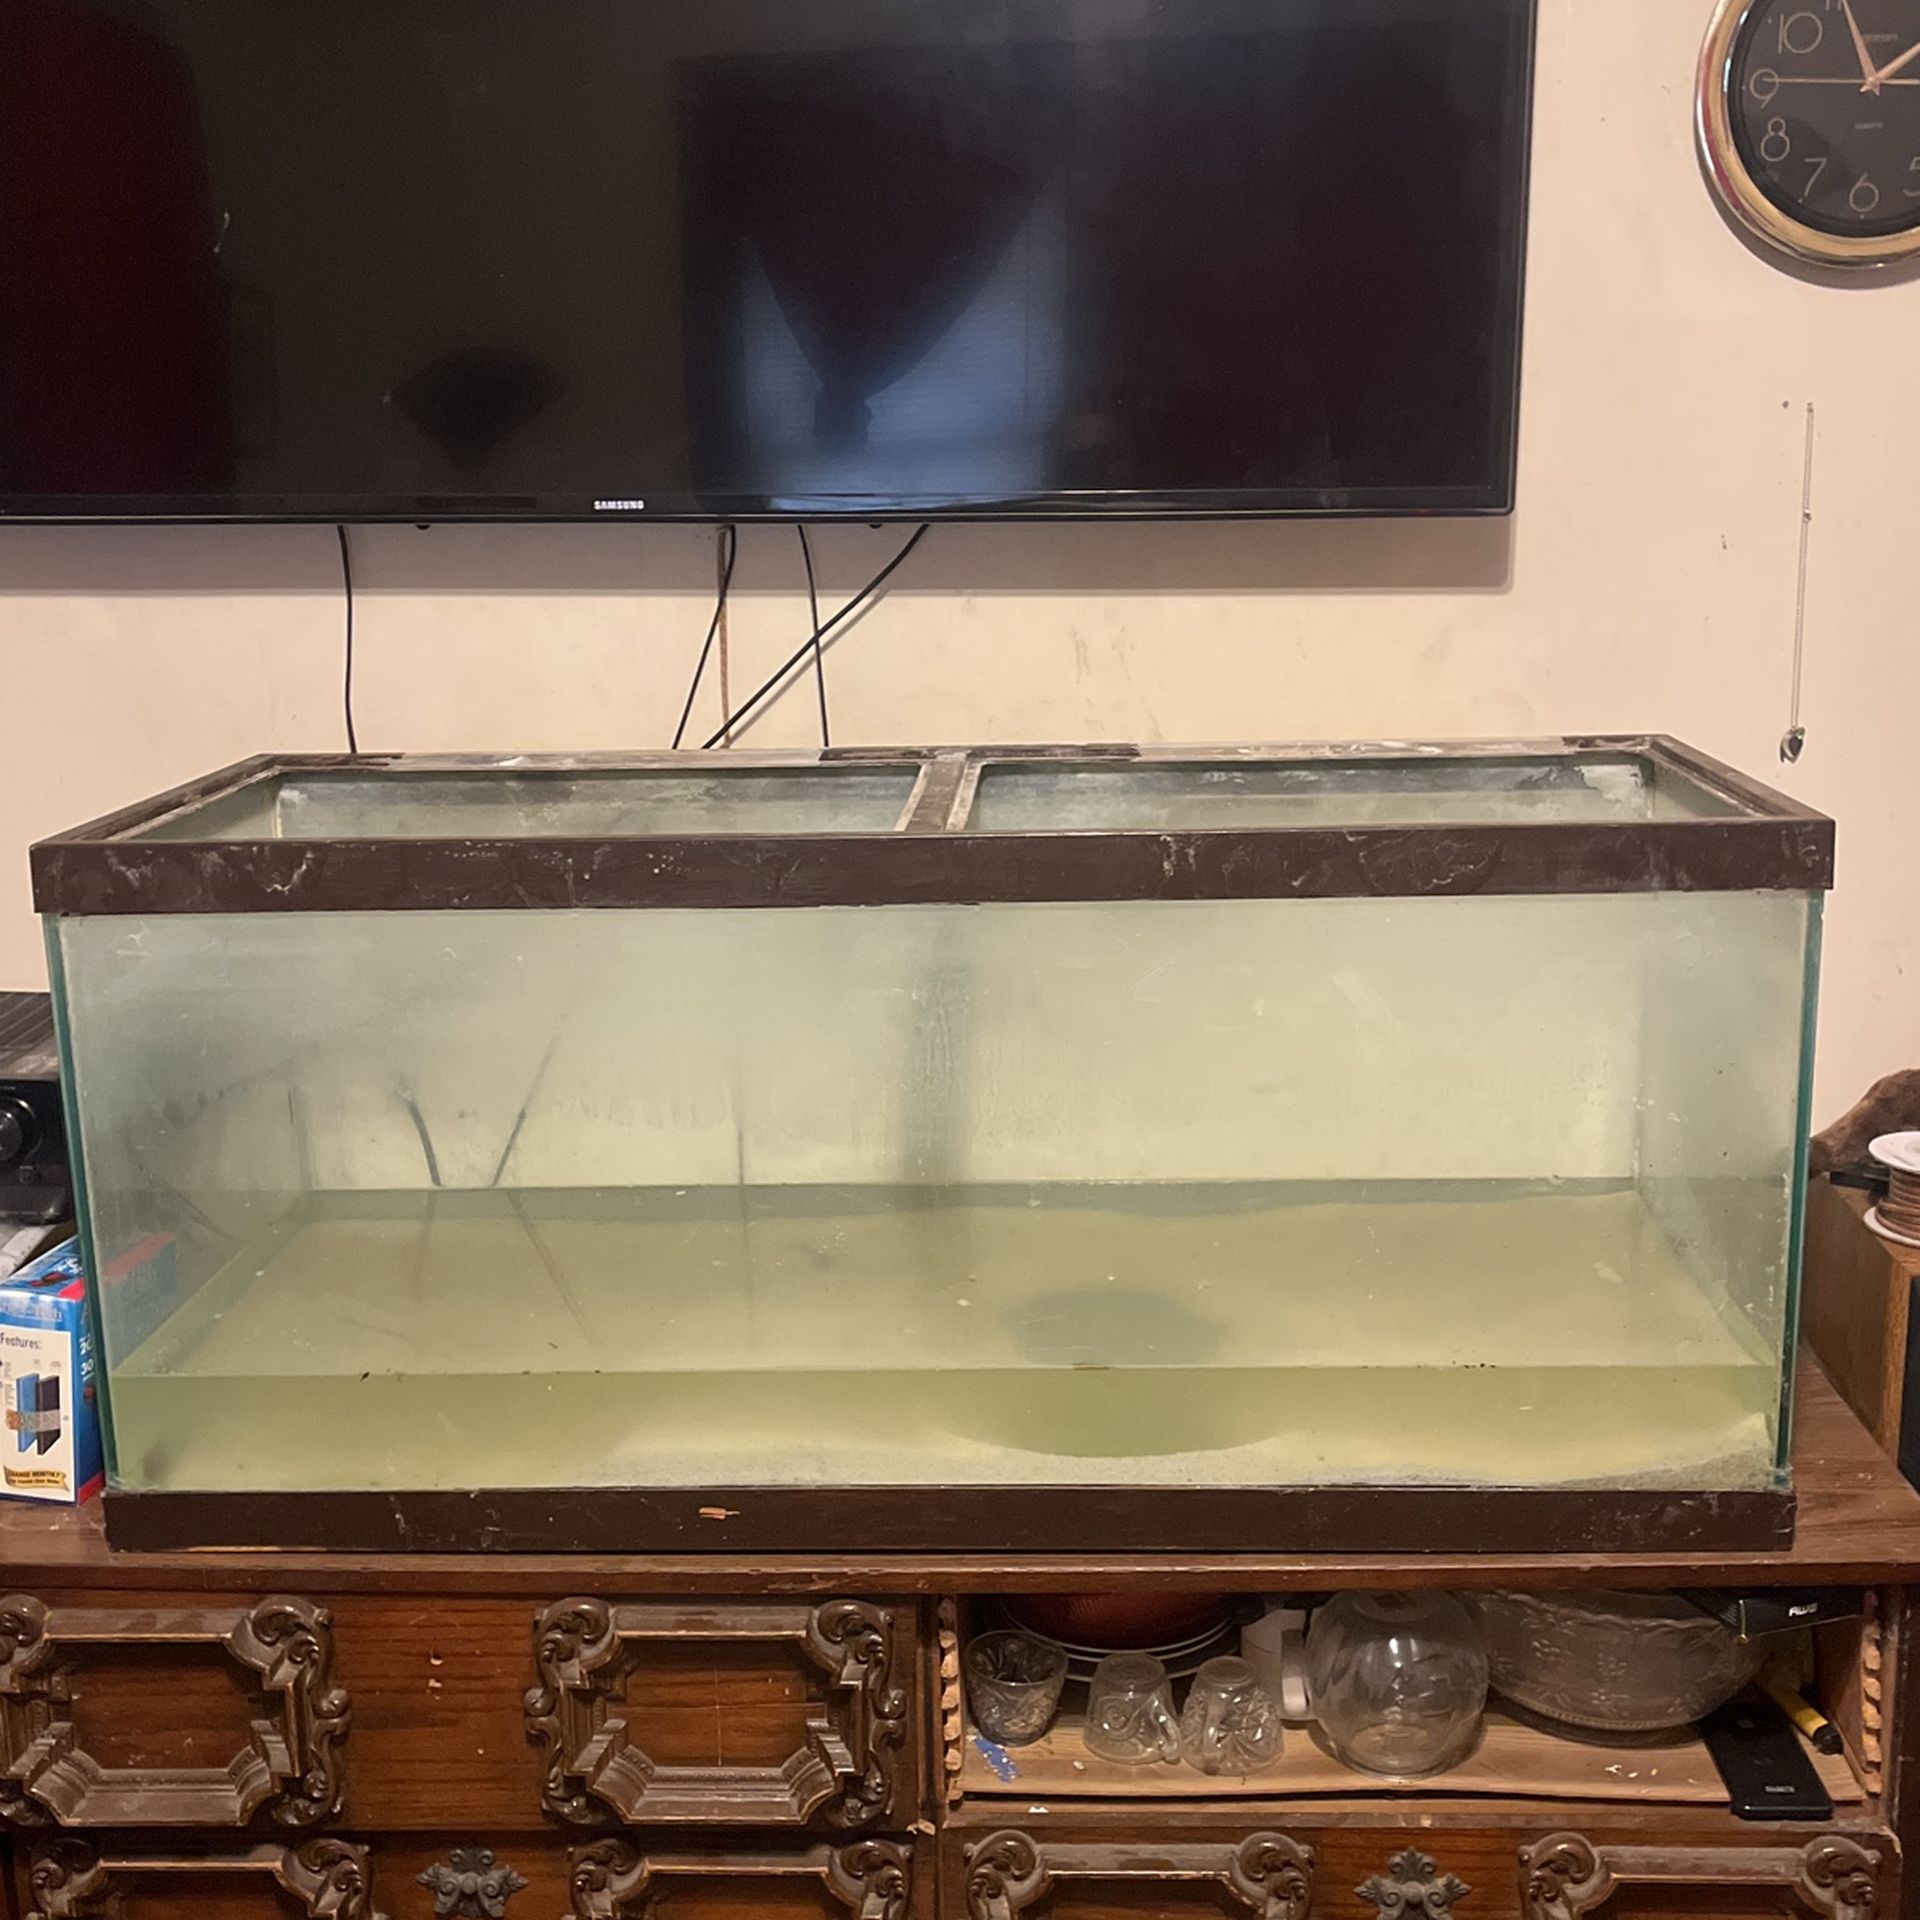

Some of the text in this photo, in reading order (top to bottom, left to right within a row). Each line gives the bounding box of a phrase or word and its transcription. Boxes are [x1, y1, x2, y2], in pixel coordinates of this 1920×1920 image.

[1777, 12, 1823, 54] 10
[1750, 68, 1779, 109] 9
[1760, 118, 1790, 162] 8
[1804, 158, 1827, 197] 7
[1849, 172, 1879, 212] 6
[594, 500, 644, 510] SAMSUNG
